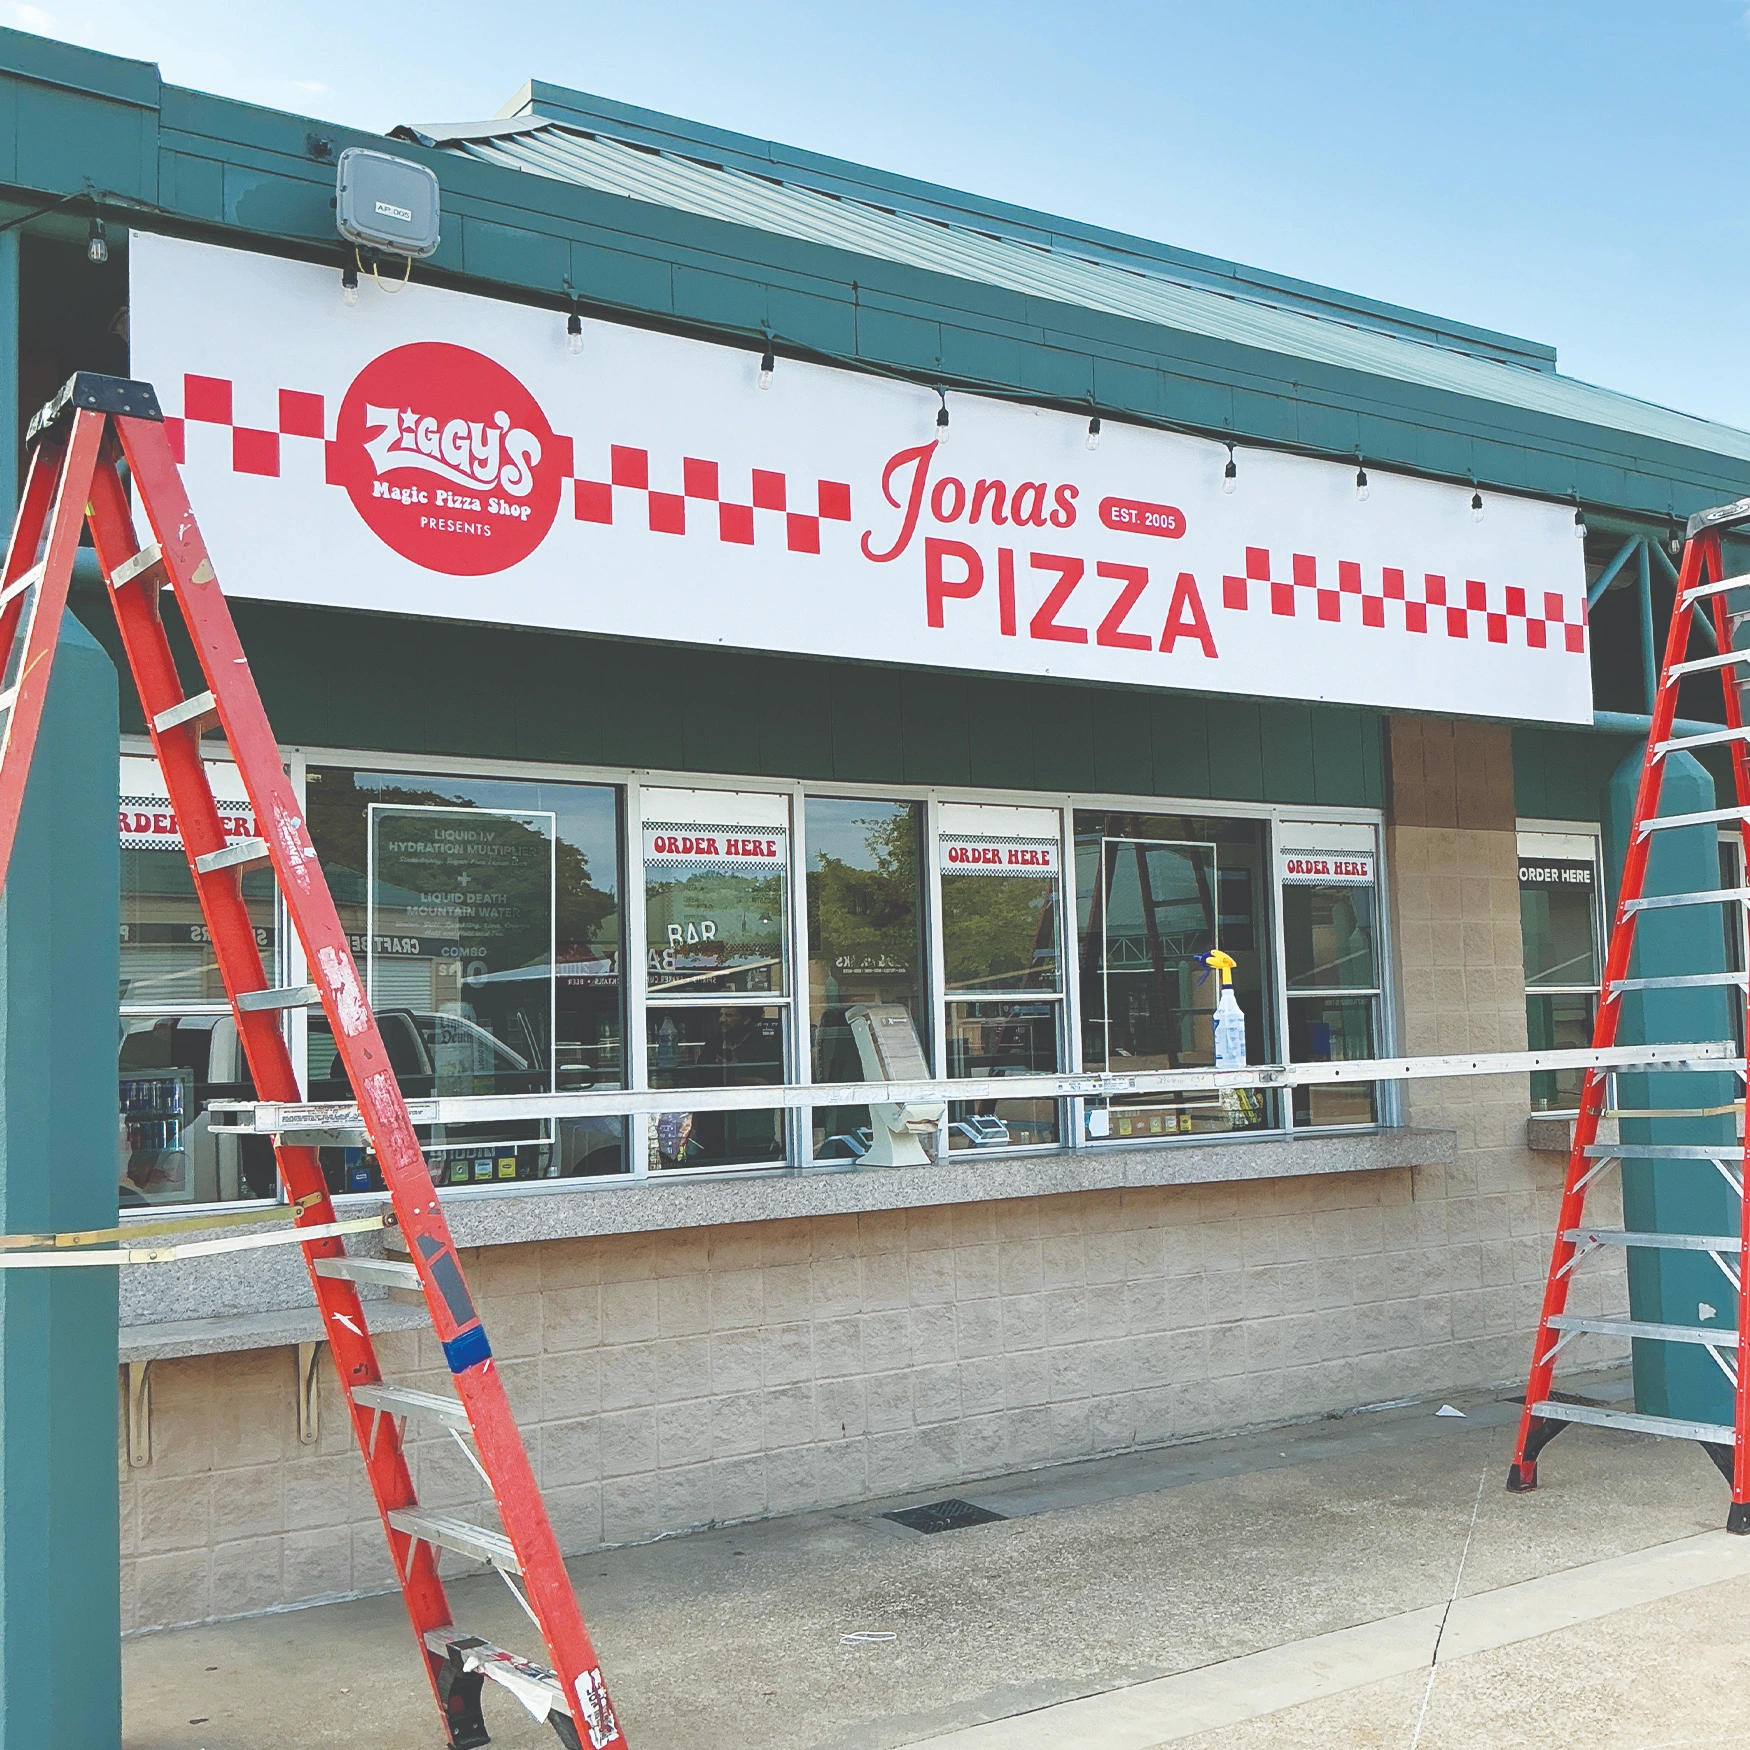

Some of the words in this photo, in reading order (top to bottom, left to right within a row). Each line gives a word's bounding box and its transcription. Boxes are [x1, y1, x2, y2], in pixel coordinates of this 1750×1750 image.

[372, 480, 429, 505] Magic
[435, 489, 482, 512] Pizza
[487, 497, 532, 521] Shop
[861, 439, 1080, 563] Jonas
[420, 516, 492, 537] PRESENTS
[1111, 505, 1140, 524] EST.
[1145, 511, 1176, 530] 2005
[925, 536, 1219, 659] PIZZA
[389, 841, 464, 854] HYDRATION
[654, 836, 720, 856] ORDER
[725, 839, 777, 857] HERE
[948, 847, 1003, 865] ORDER
[1007, 849, 1050, 866] HERE
[1287, 859, 1330, 875] ORDER
[1334, 861, 1368, 877] HERE
[1519, 867, 1559, 882] ORDER
[1561, 869, 1591, 883] HERE
[421, 892, 464, 903] LIQUID
[467, 893, 507, 904] DEATH
[406, 906, 475, 917] MOUNTAIN
[478, 906, 520, 918] WATER
[668, 921, 716, 947] BAR
[441, 946, 488, 958] COMBO
